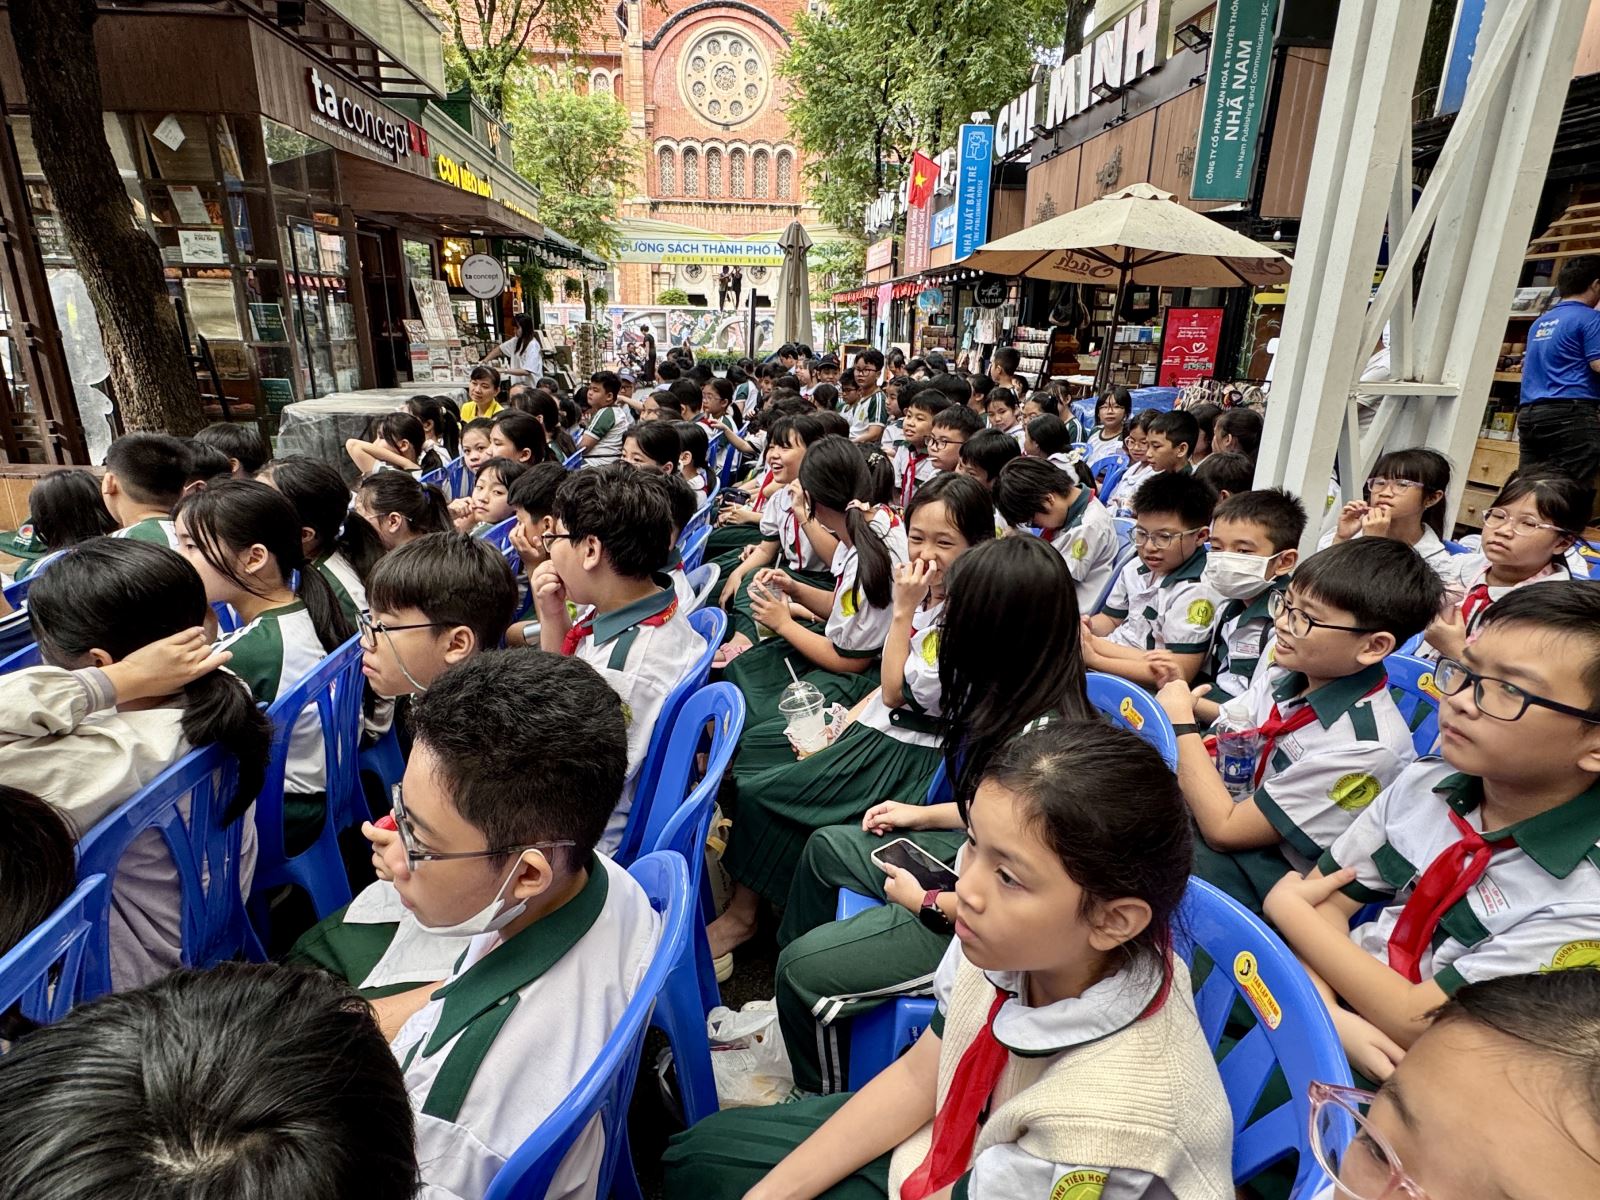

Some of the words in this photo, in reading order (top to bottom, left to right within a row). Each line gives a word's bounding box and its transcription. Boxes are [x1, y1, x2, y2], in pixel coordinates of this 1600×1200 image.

[1223, 25, 1236, 59] TRUYỀN
[1250, 17, 1267, 84] Communications
[1233, 40, 1253, 90] NAM
[995, 63, 1042, 158] CHÍ
[1045, 0, 1162, 130] MINH
[1218, 70, 1229, 88] HOÁ
[1216, 90, 1226, 108] VĂN
[1247, 85, 1257, 101] and
[310, 67, 340, 120] ta
[342, 97, 411, 164] concept
[1212, 110, 1223, 134] PHẦN
[1224, 96, 1245, 141] NHÃ
[1240, 102, 1255, 142] Publishing
[1209, 136, 1219, 148] CỔ
[1210, 149, 1217, 158] TY
[1238, 143, 1247, 161] Nam
[439, 154, 460, 188] CON
[967, 165, 977, 183] TRẺ
[1206, 161, 1216, 184] CÔNG
[1235, 163, 1244, 178] Nha
[966, 186, 976, 205] BẢN
[964, 208, 974, 231] XUẤT
[974, 198, 982, 231] PUBLISHING
[667, 241, 699, 253] SÁCH
[702, 242, 743, 254] THÀNH
[746, 243, 771, 255] PHỐ
[774, 245, 785, 255] H
[963, 233, 972, 252] NHÀ
